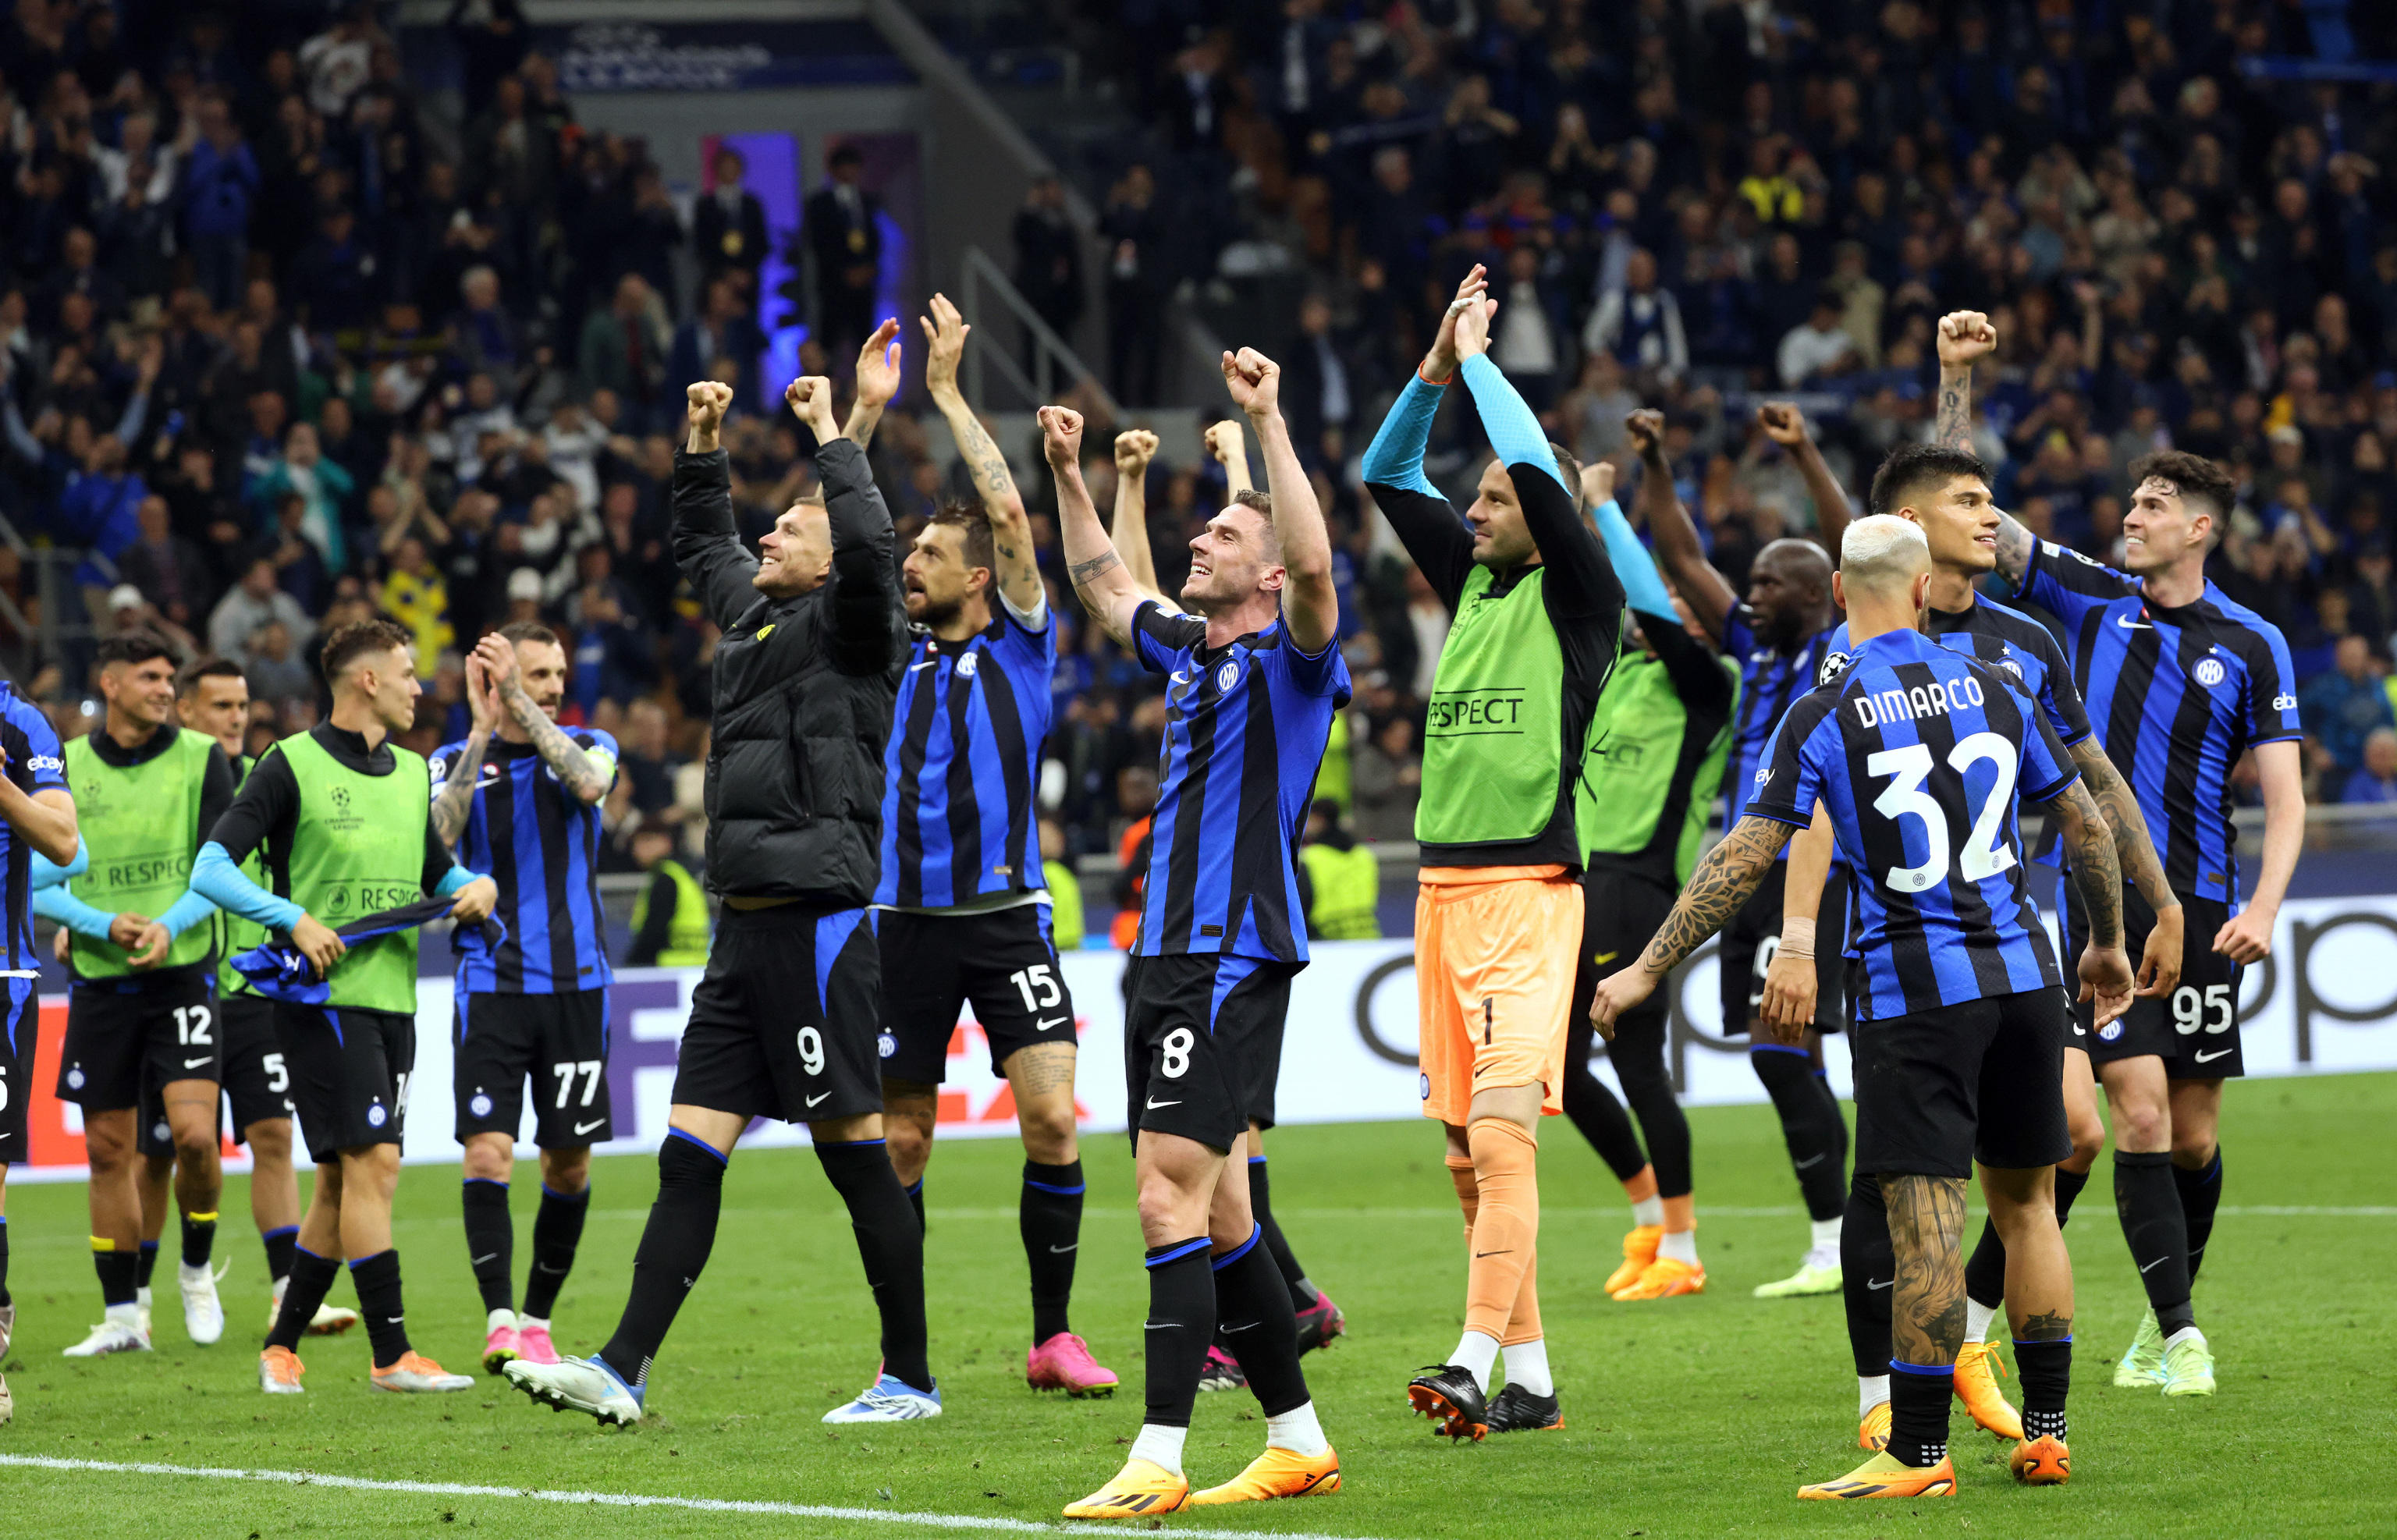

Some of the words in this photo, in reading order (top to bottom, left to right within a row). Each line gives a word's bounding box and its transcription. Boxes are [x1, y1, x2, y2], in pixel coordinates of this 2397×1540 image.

[1429, 698, 1523, 728] SPECT
[1854, 676, 1984, 729] DIMARCO
[2272, 691, 2297, 711] eb
[27, 754, 65, 774] ebay
[1867, 732, 2018, 892] 32
[1010, 964, 1061, 1013] 15
[2172, 984, 2232, 1035] 95
[172, 1005, 212, 1045] 12
[1482, 997, 1493, 1045] 1
[263, 1053, 289, 1092] 5
[797, 1026, 825, 1076] 9
[1162, 1027, 1195, 1078] 8
[554, 1060, 602, 1109] 77
